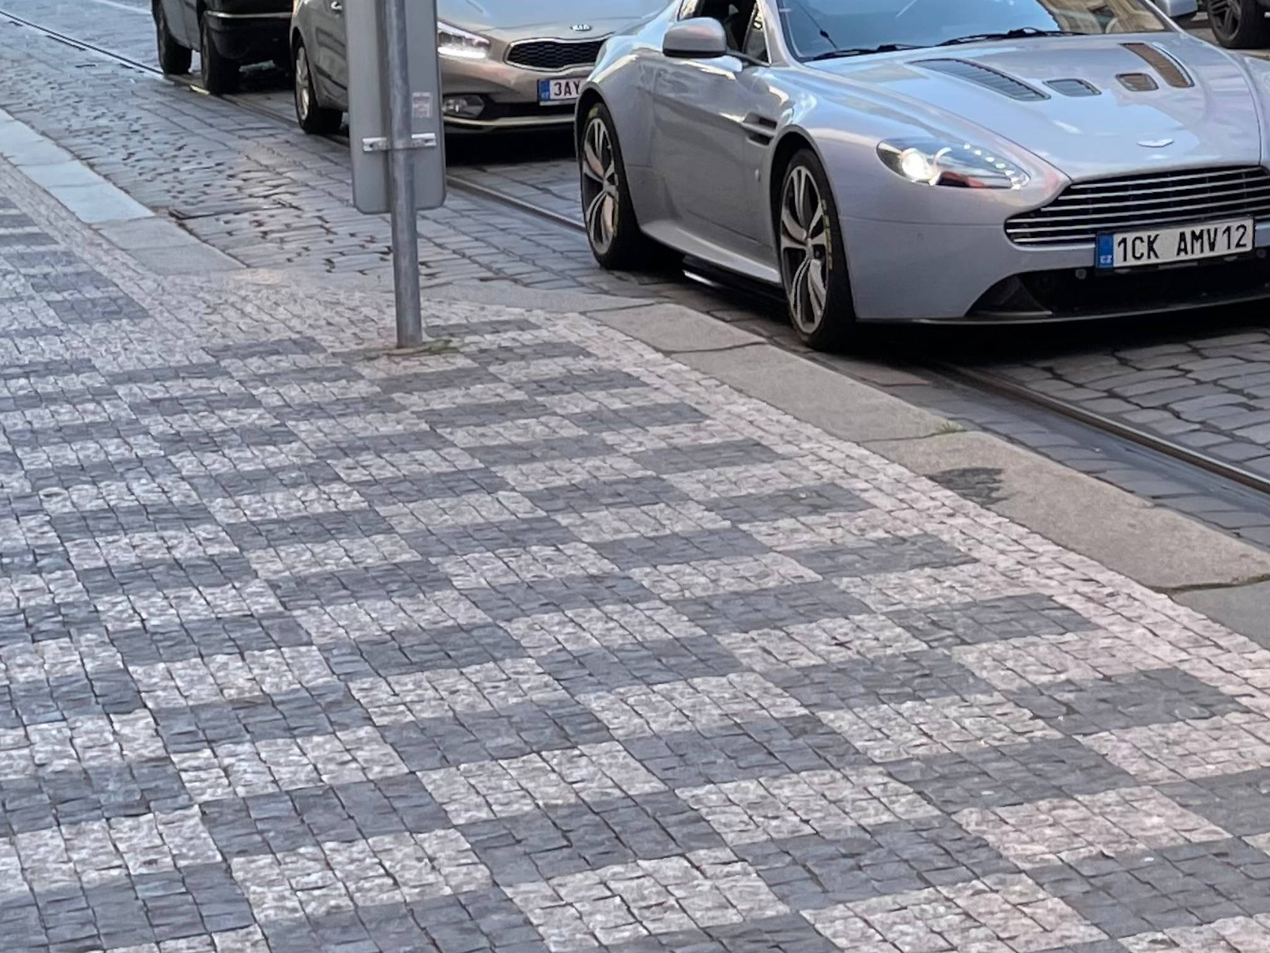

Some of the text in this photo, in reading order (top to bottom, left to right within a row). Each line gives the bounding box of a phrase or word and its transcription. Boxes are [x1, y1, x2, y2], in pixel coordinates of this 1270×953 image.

[553, 80, 581, 97] 3AY
[1117, 233, 1160, 262] 1CK
[1176, 224, 1247, 257] AMV12
